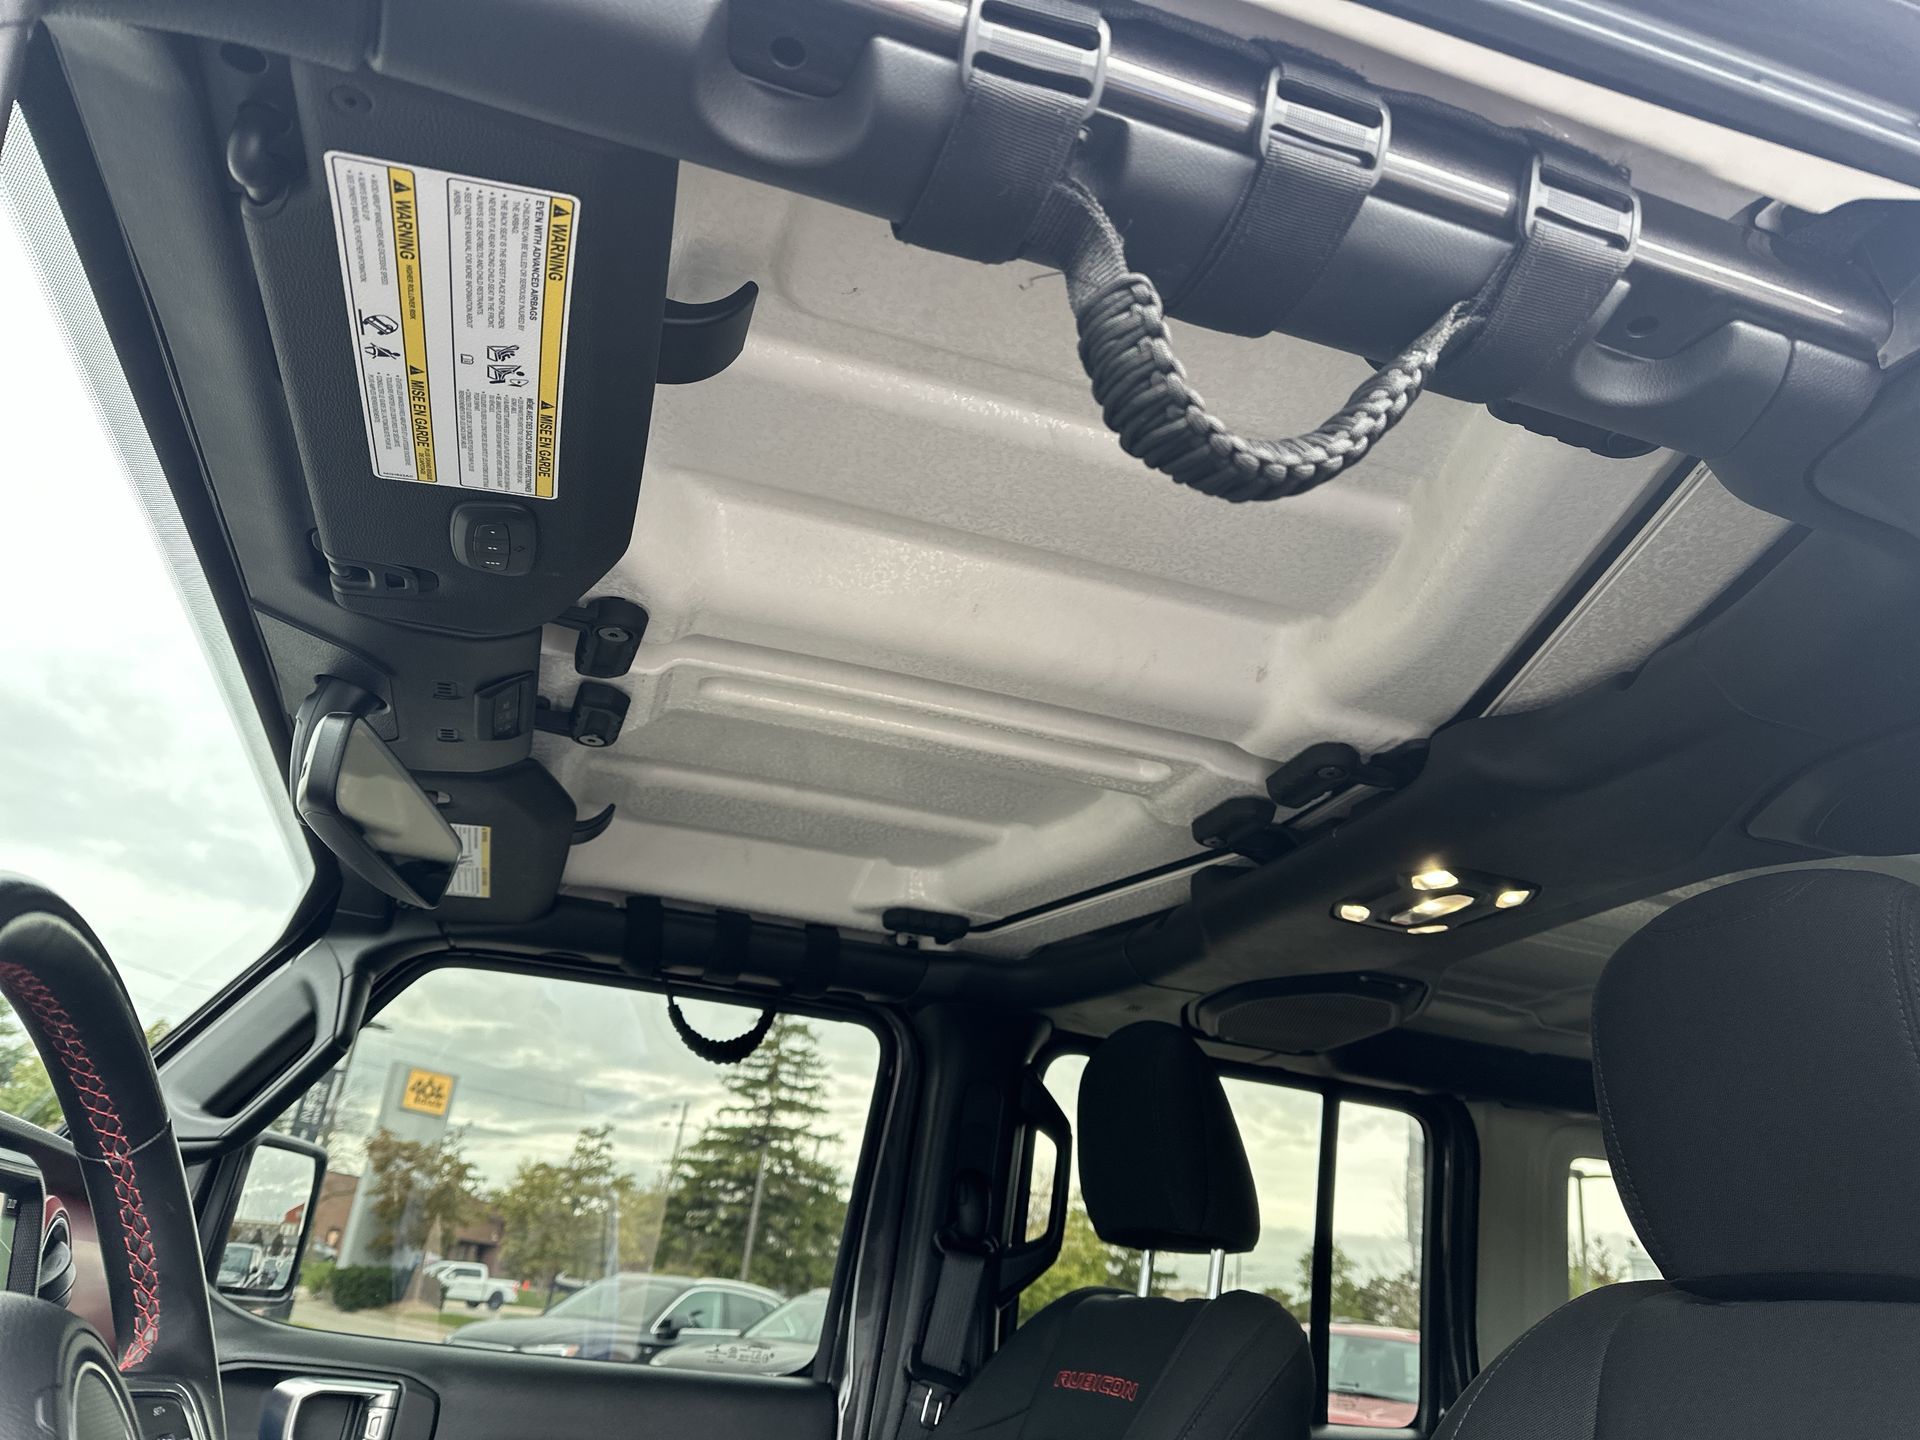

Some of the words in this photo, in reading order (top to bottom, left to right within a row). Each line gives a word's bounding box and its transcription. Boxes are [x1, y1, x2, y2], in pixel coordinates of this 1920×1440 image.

[534, 200, 543, 223] EVEN
[395, 199, 415, 260] WARNING
[533, 224, 542, 245] WITH
[531, 245, 541, 287] ADVANCED
[549, 223, 567, 282] WARNING
[529, 288, 538, 321] AIRBAGS
[411, 380, 425, 402] MISE
[413, 403, 426, 416] EN
[414, 417, 429, 447] GARDE
[539, 414, 552, 435] MISE
[539, 436, 551, 448] EN
[538, 449, 551, 477] GARDE
[1054, 1370, 1139, 1401] RUBICON
